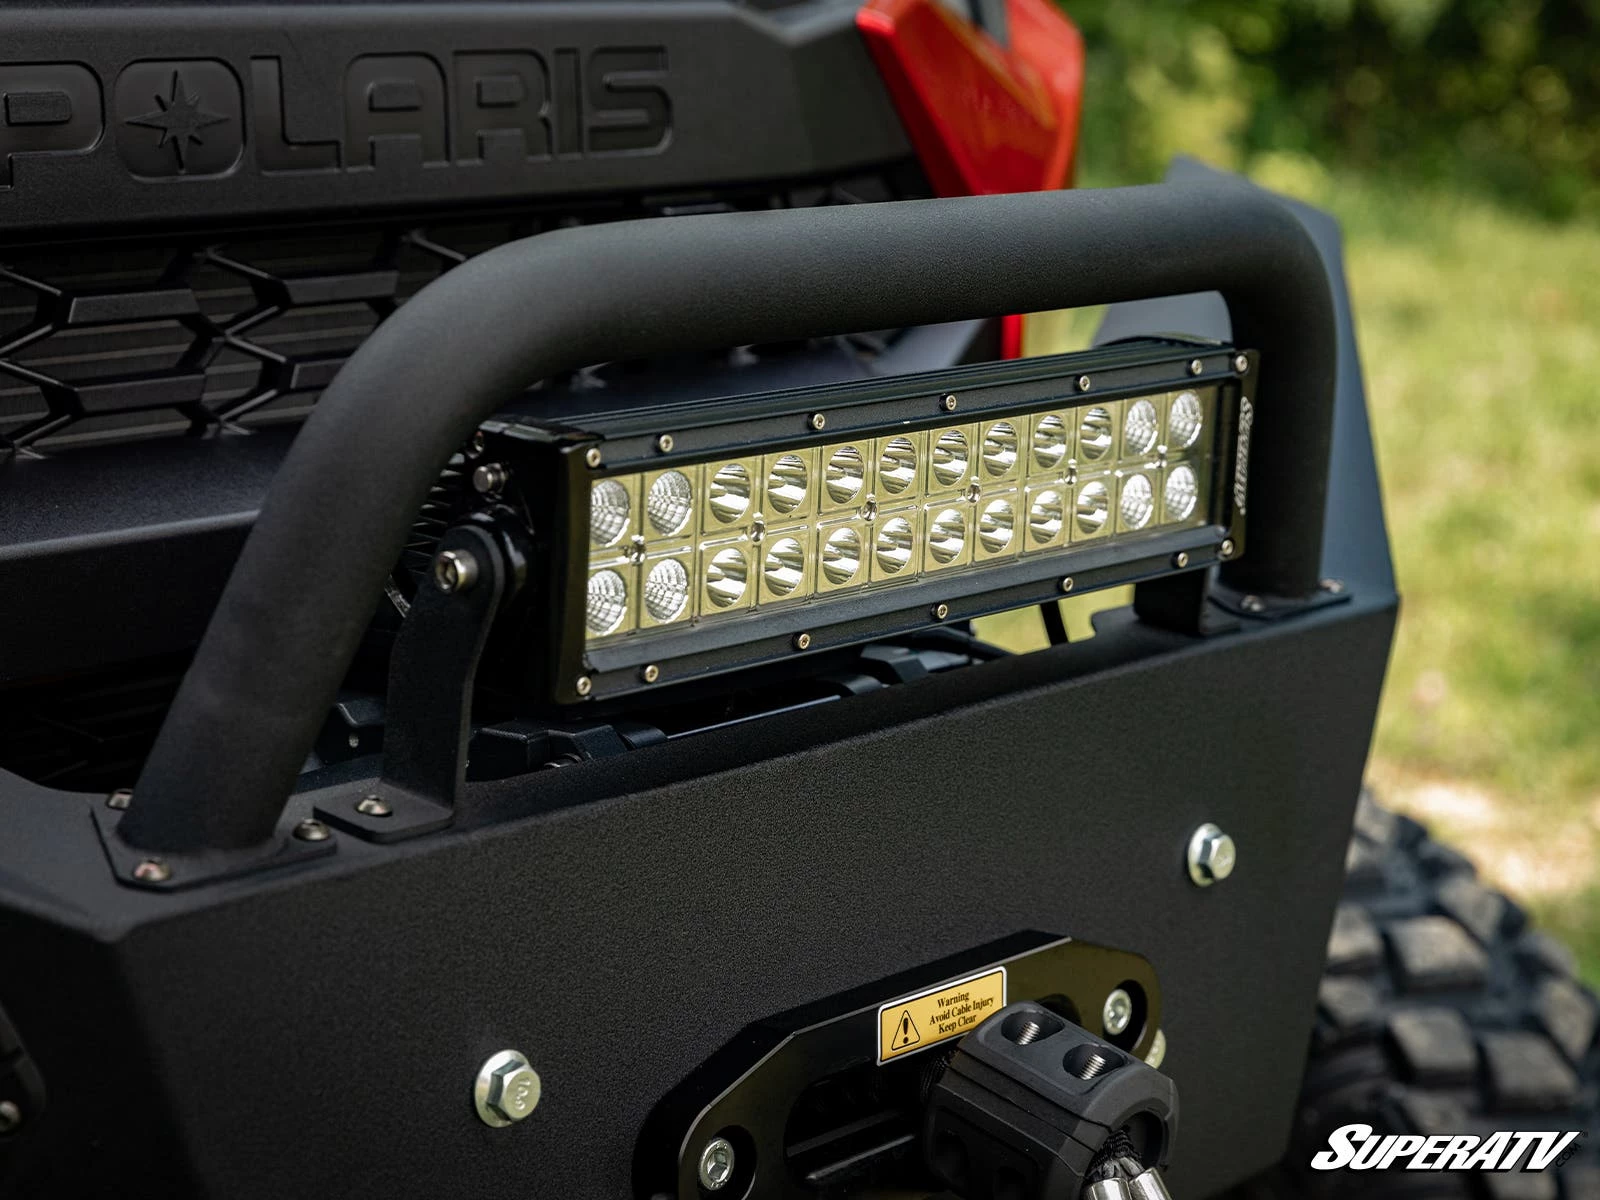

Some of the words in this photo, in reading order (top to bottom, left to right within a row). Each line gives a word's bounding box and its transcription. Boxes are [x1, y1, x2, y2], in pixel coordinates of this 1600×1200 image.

[0, 45, 672, 189] POLARIS
[929, 1009, 950, 1025] Avoid
[951, 1004, 972, 1018] Cable
[972, 997, 994, 1010] Injury
[937, 992, 970, 1008] Warning
[938, 1021, 957, 1034] Keep
[957, 1014, 977, 1027] Clear
